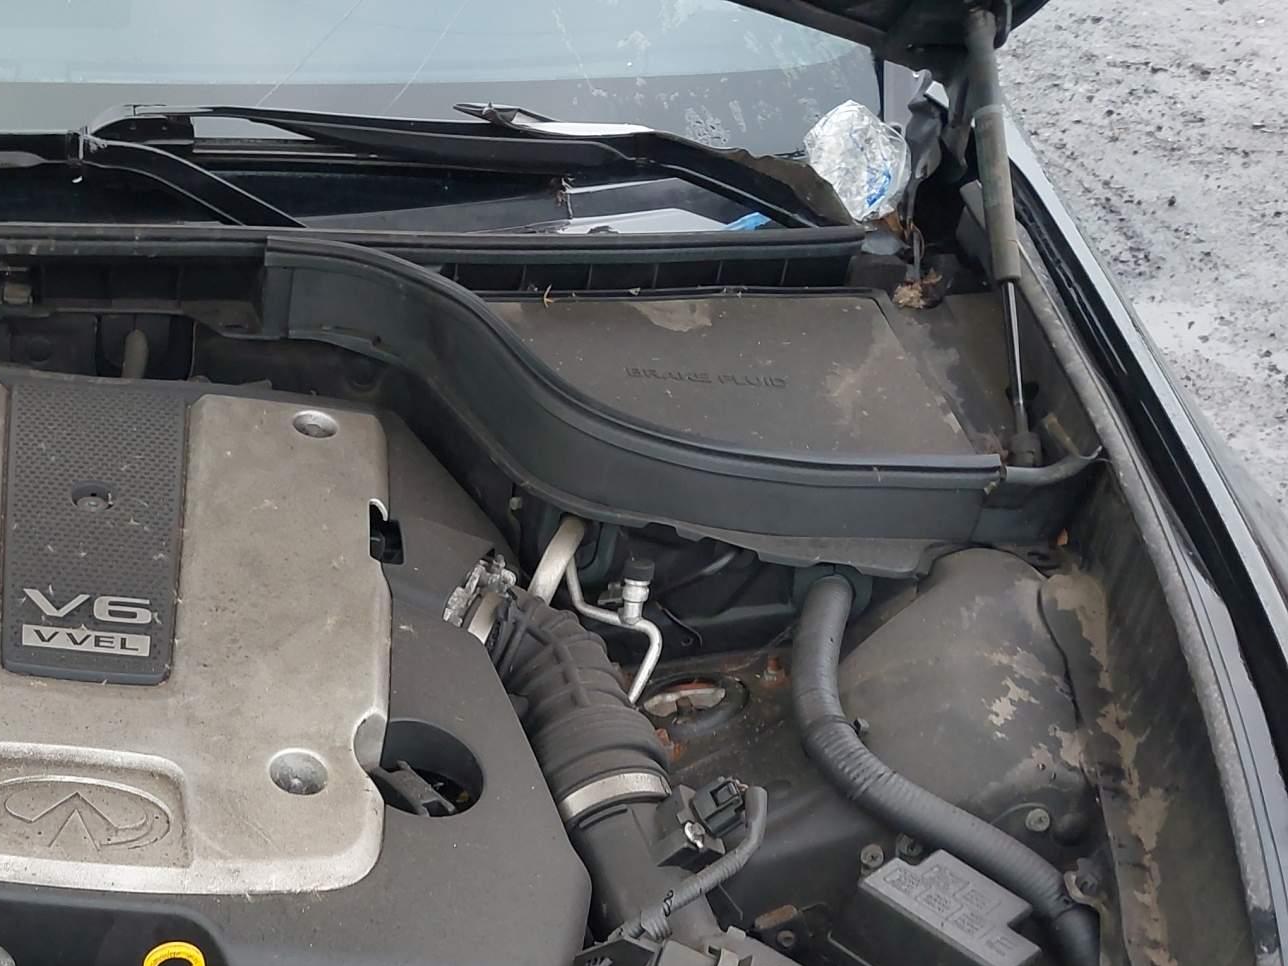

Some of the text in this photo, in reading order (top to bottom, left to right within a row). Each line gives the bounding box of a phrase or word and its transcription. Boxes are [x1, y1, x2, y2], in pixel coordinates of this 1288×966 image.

[624, 366, 788, 389] BRAKE FLUID
[23, 588, 152, 624] V6
[34, 629, 139, 651] VVEL
